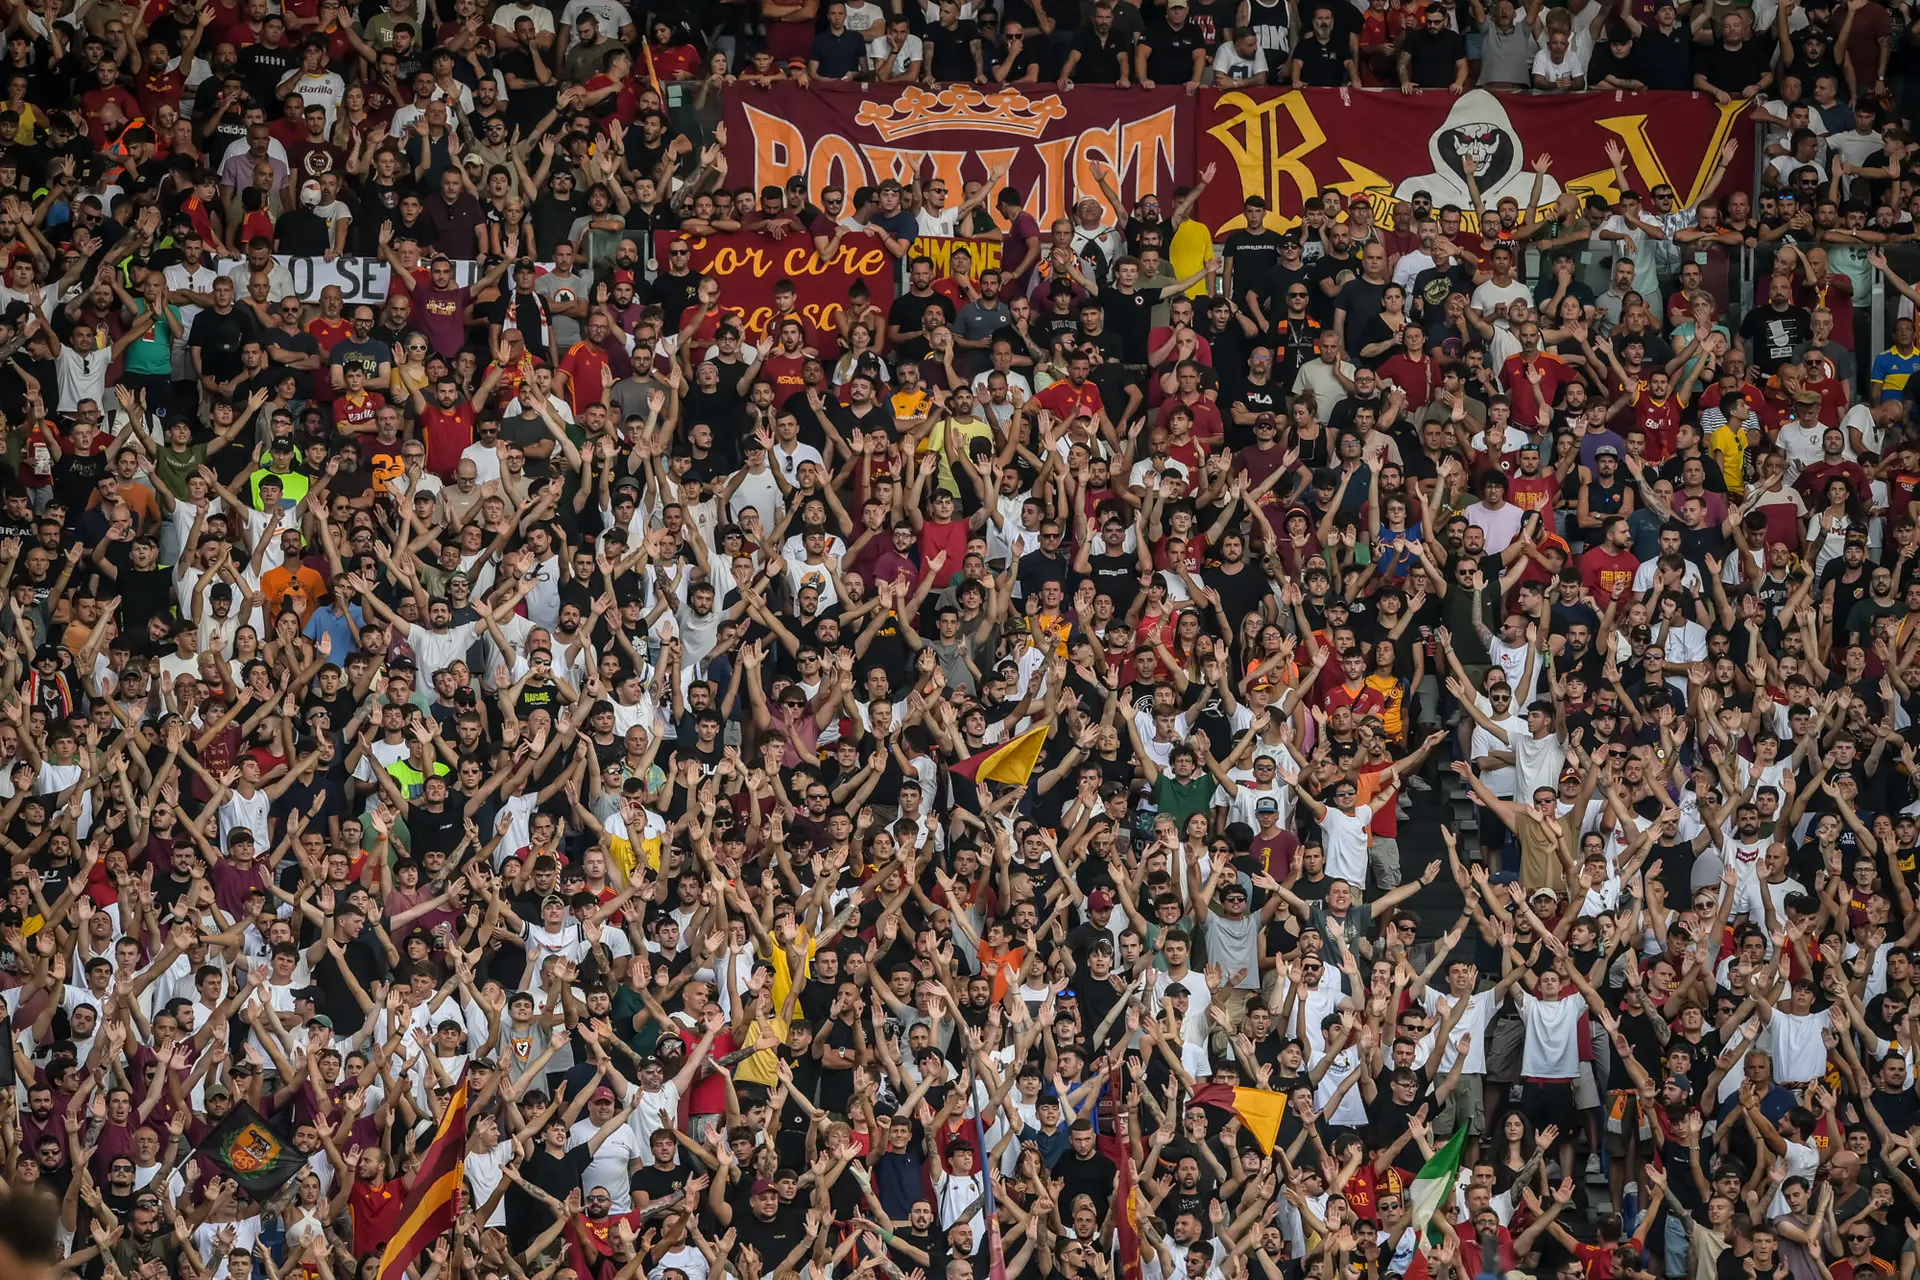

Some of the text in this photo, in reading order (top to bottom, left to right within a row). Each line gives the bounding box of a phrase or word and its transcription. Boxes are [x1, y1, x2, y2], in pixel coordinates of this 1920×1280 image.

[299, 85, 333, 95] Barilla
[217, 125, 248, 136] adidas
[783, 243, 885, 277] core
[1247, 392, 1273, 405] FILA
[1346, 1192, 1370, 1206] PQR
